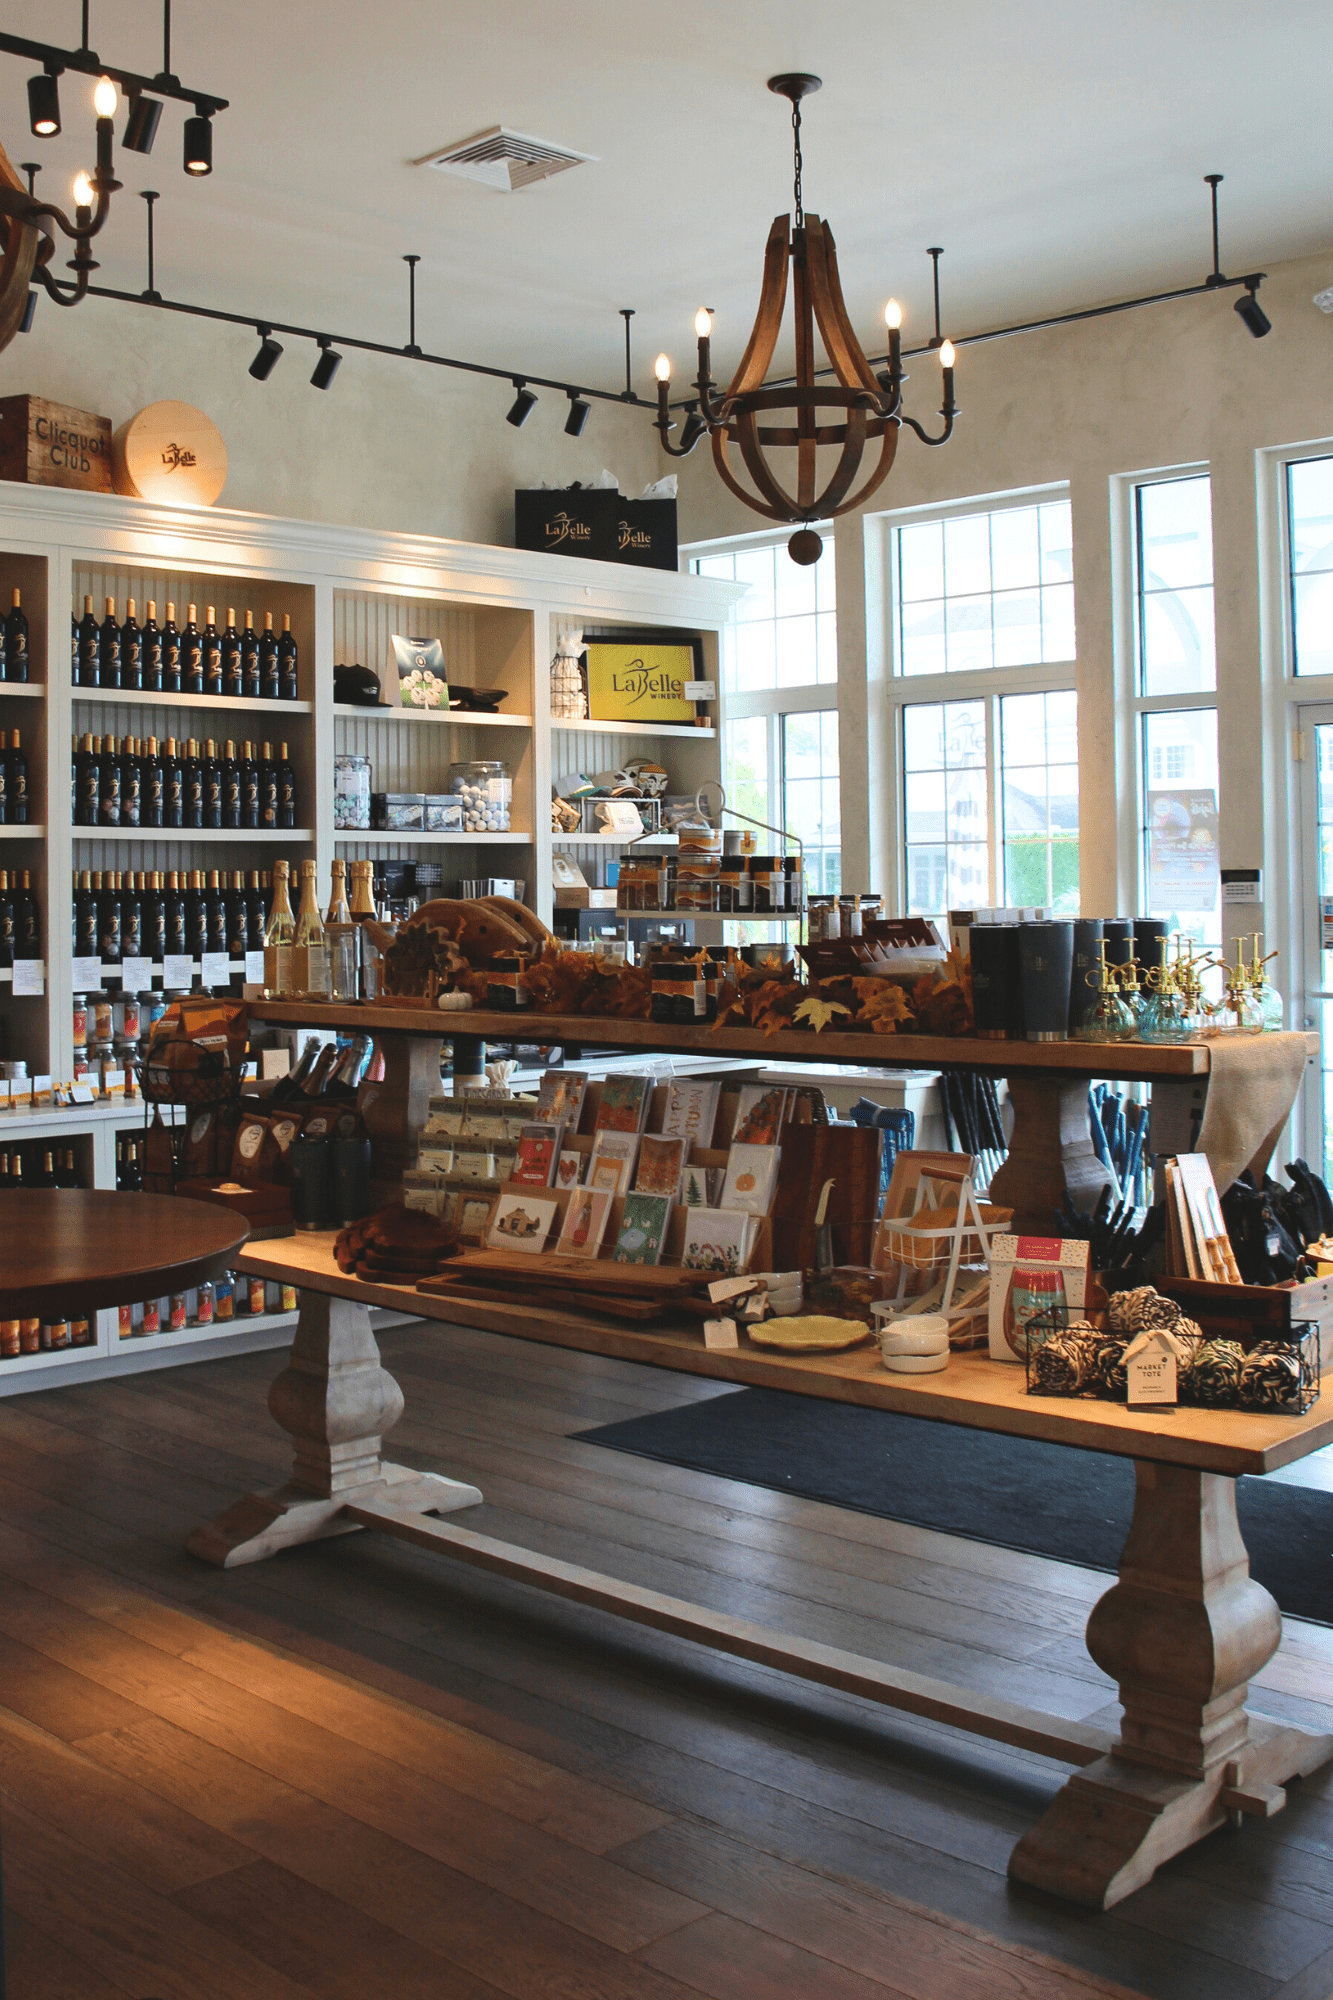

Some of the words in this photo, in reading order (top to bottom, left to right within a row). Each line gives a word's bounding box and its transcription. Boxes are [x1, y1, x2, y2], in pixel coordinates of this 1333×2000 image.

[36, 417, 105, 456] Clicquot
[50, 445, 91, 473] Club
[545, 516, 591, 548] LaBelle
[612, 663, 682, 706] LaBelle
